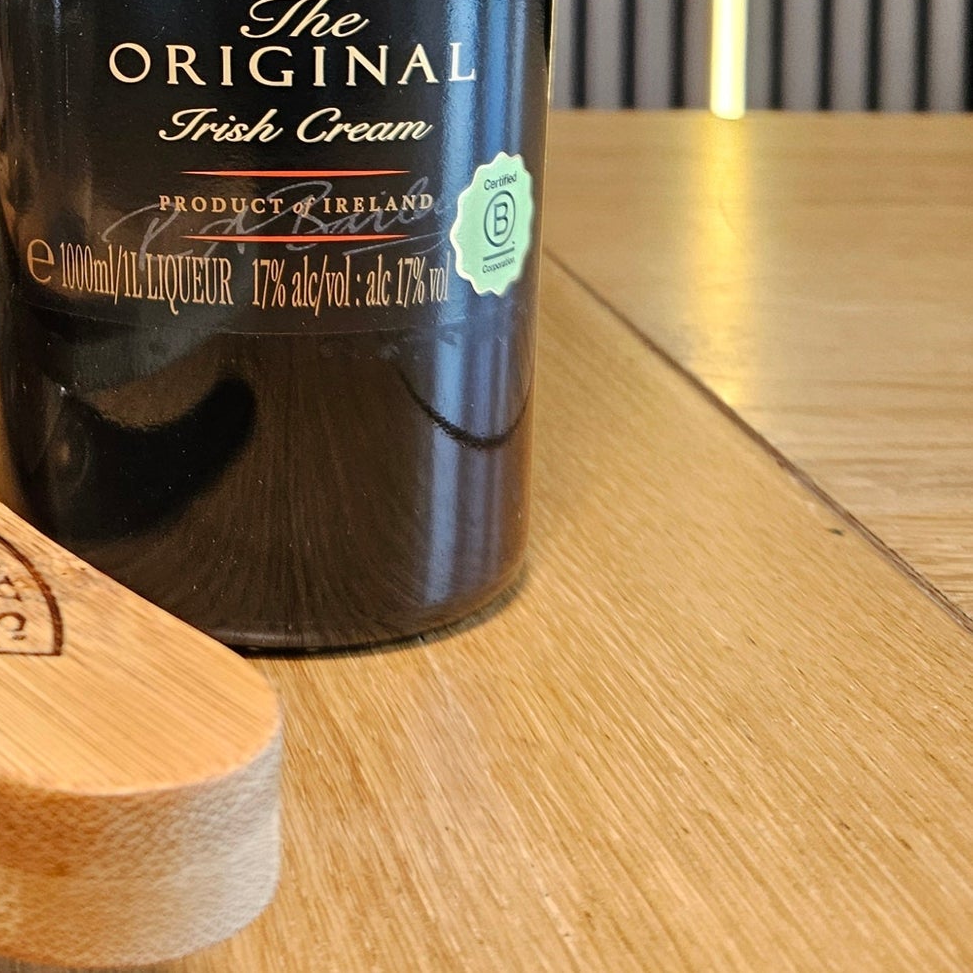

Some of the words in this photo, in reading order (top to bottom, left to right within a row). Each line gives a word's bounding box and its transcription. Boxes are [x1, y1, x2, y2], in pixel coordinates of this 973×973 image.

[108, 41, 477, 87] ORIGINAL
[158, 107, 284, 143] Irish
[296, 107, 433, 143] Cream
[483, 170, 518, 191] Certified
[159, 193, 284, 214] PRODUCT
[292, 194, 316, 217] of
[323, 193, 434, 214] IRELAND
[59, 242, 143, 306] 1000ml/1L
[145, 252, 234, 316] LIQUEUR
[252, 257, 286, 310] 17%
[291, 253, 351, 318] alc/vol
[366, 252, 391, 308] alc
[395, 255, 426, 309] 17%
[429, 249, 451, 304] vol
